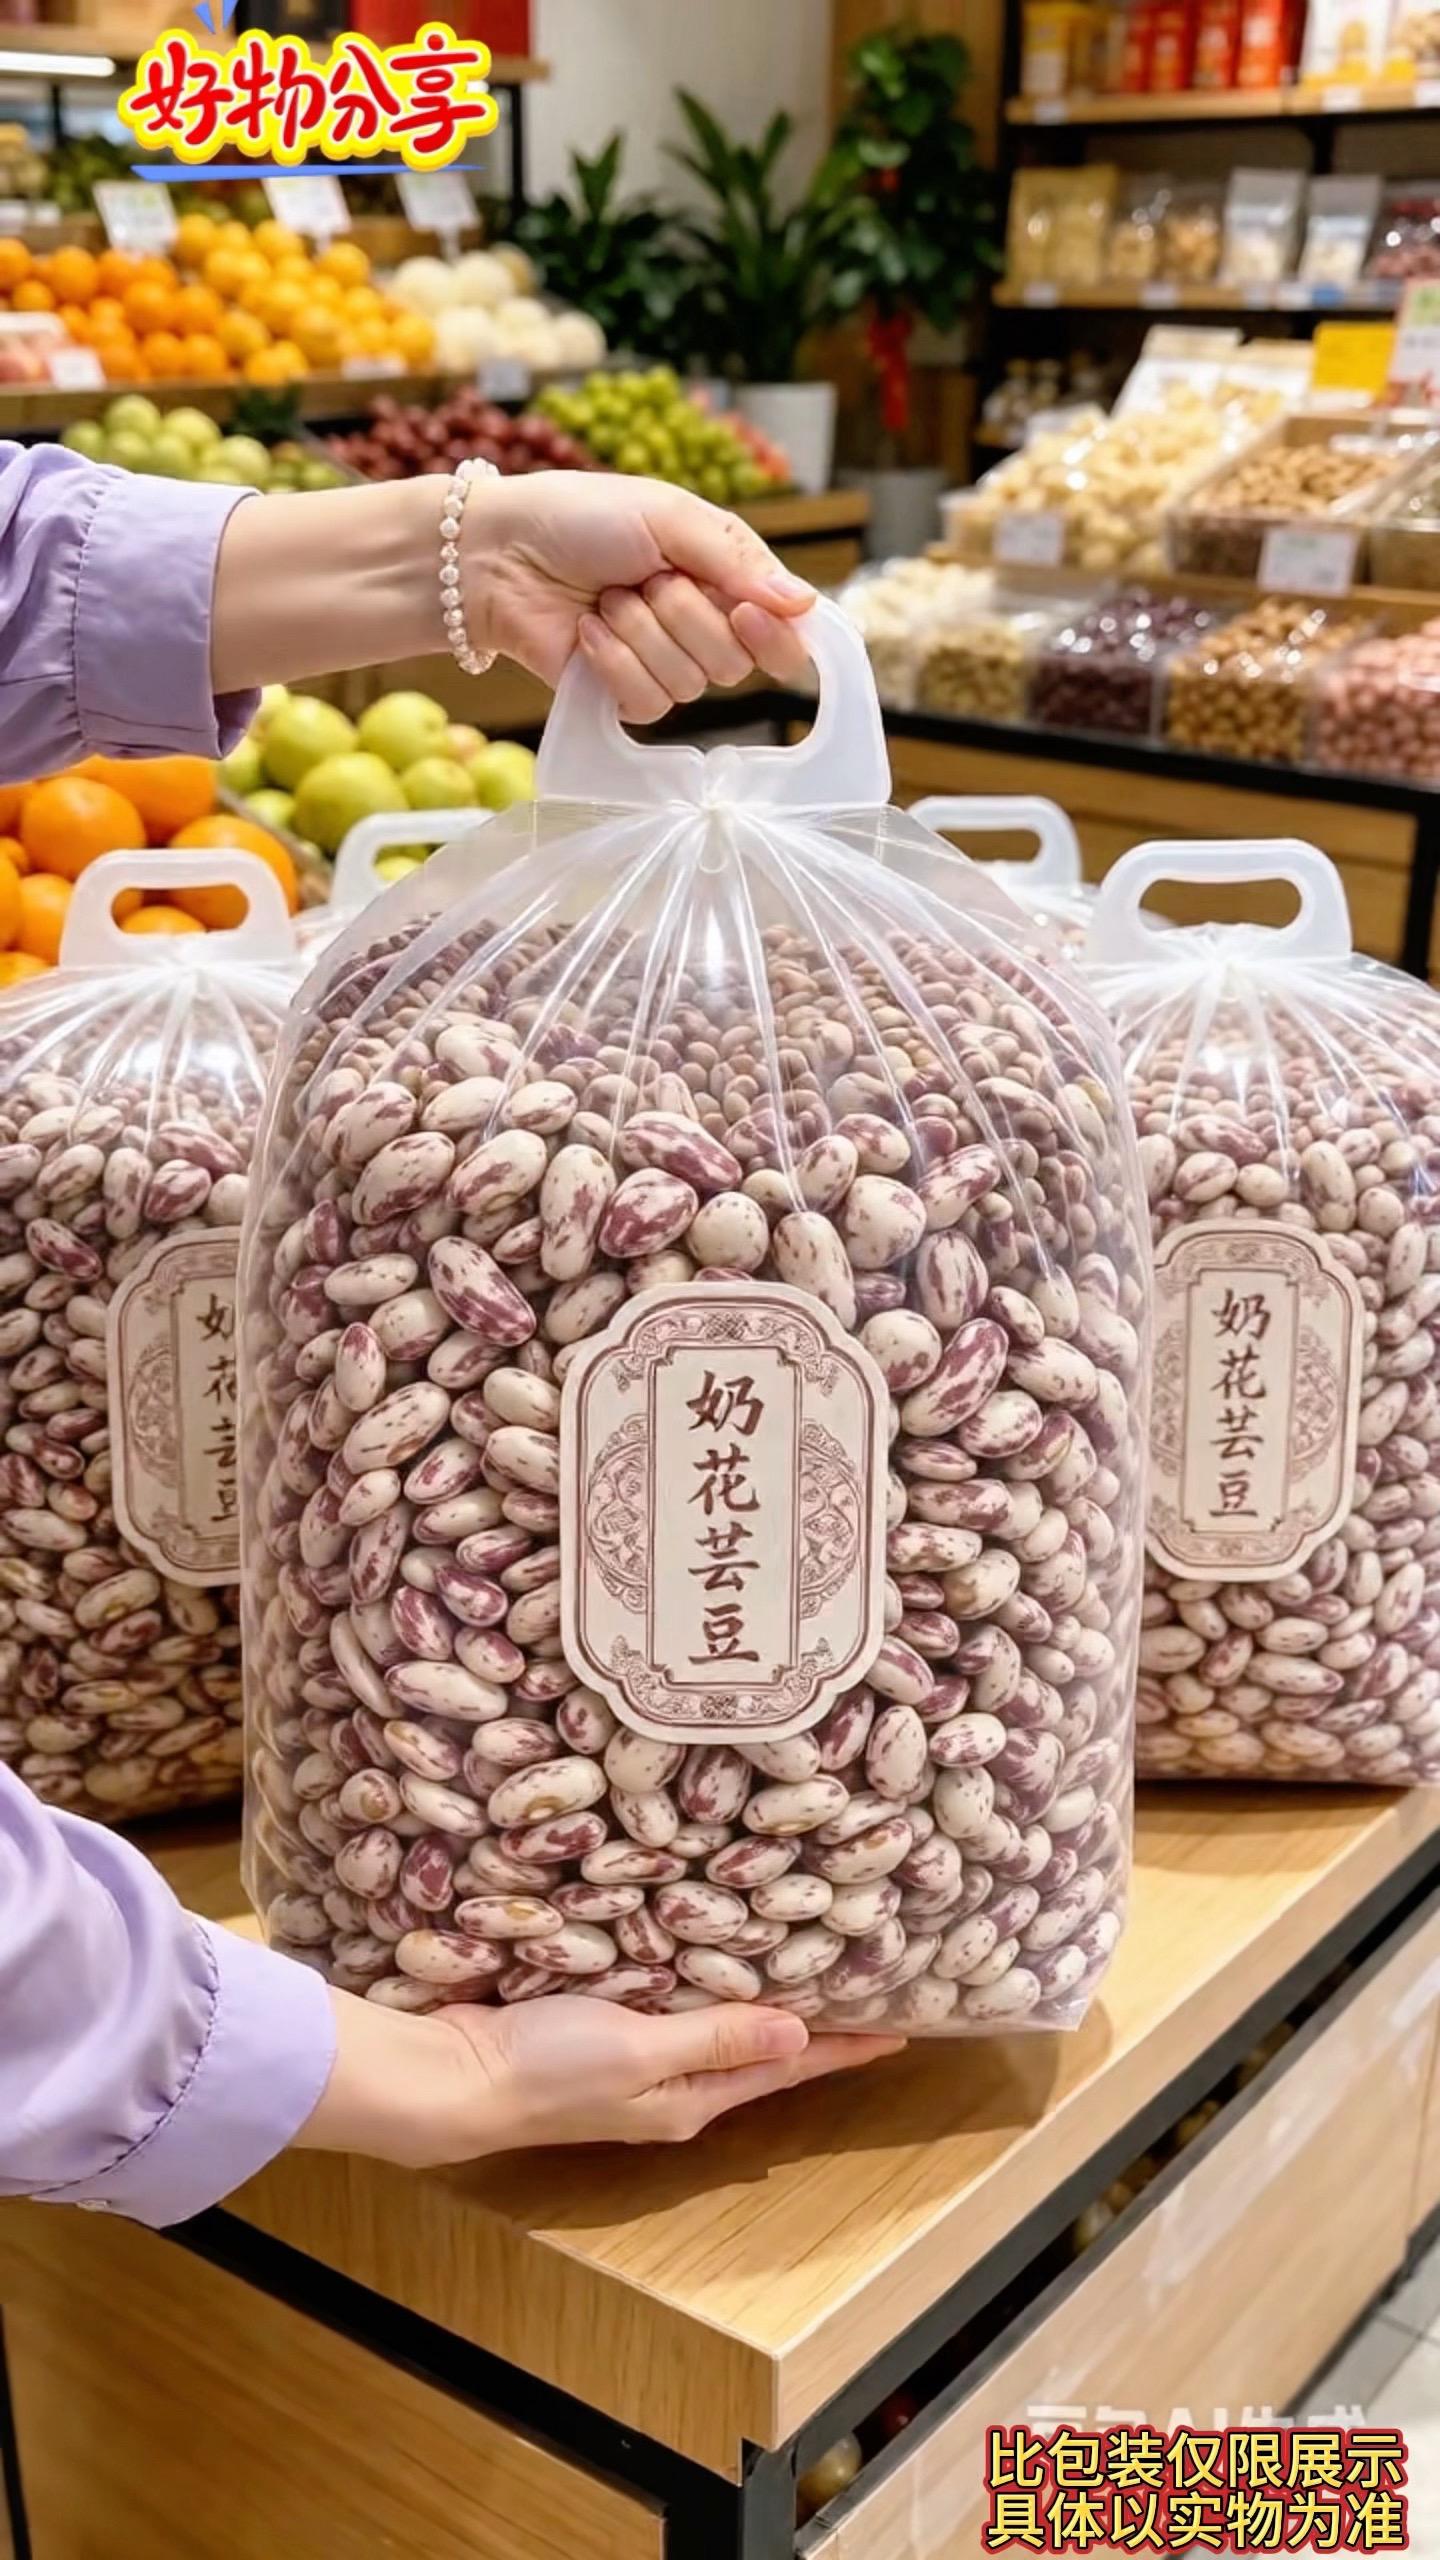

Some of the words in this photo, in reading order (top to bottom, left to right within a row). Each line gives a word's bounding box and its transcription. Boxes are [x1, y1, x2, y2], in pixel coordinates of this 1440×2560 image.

[685, 1369, 765, 1666] 奶花芸豆
[1209, 1287, 1272, 1518] 奶花芸豆
